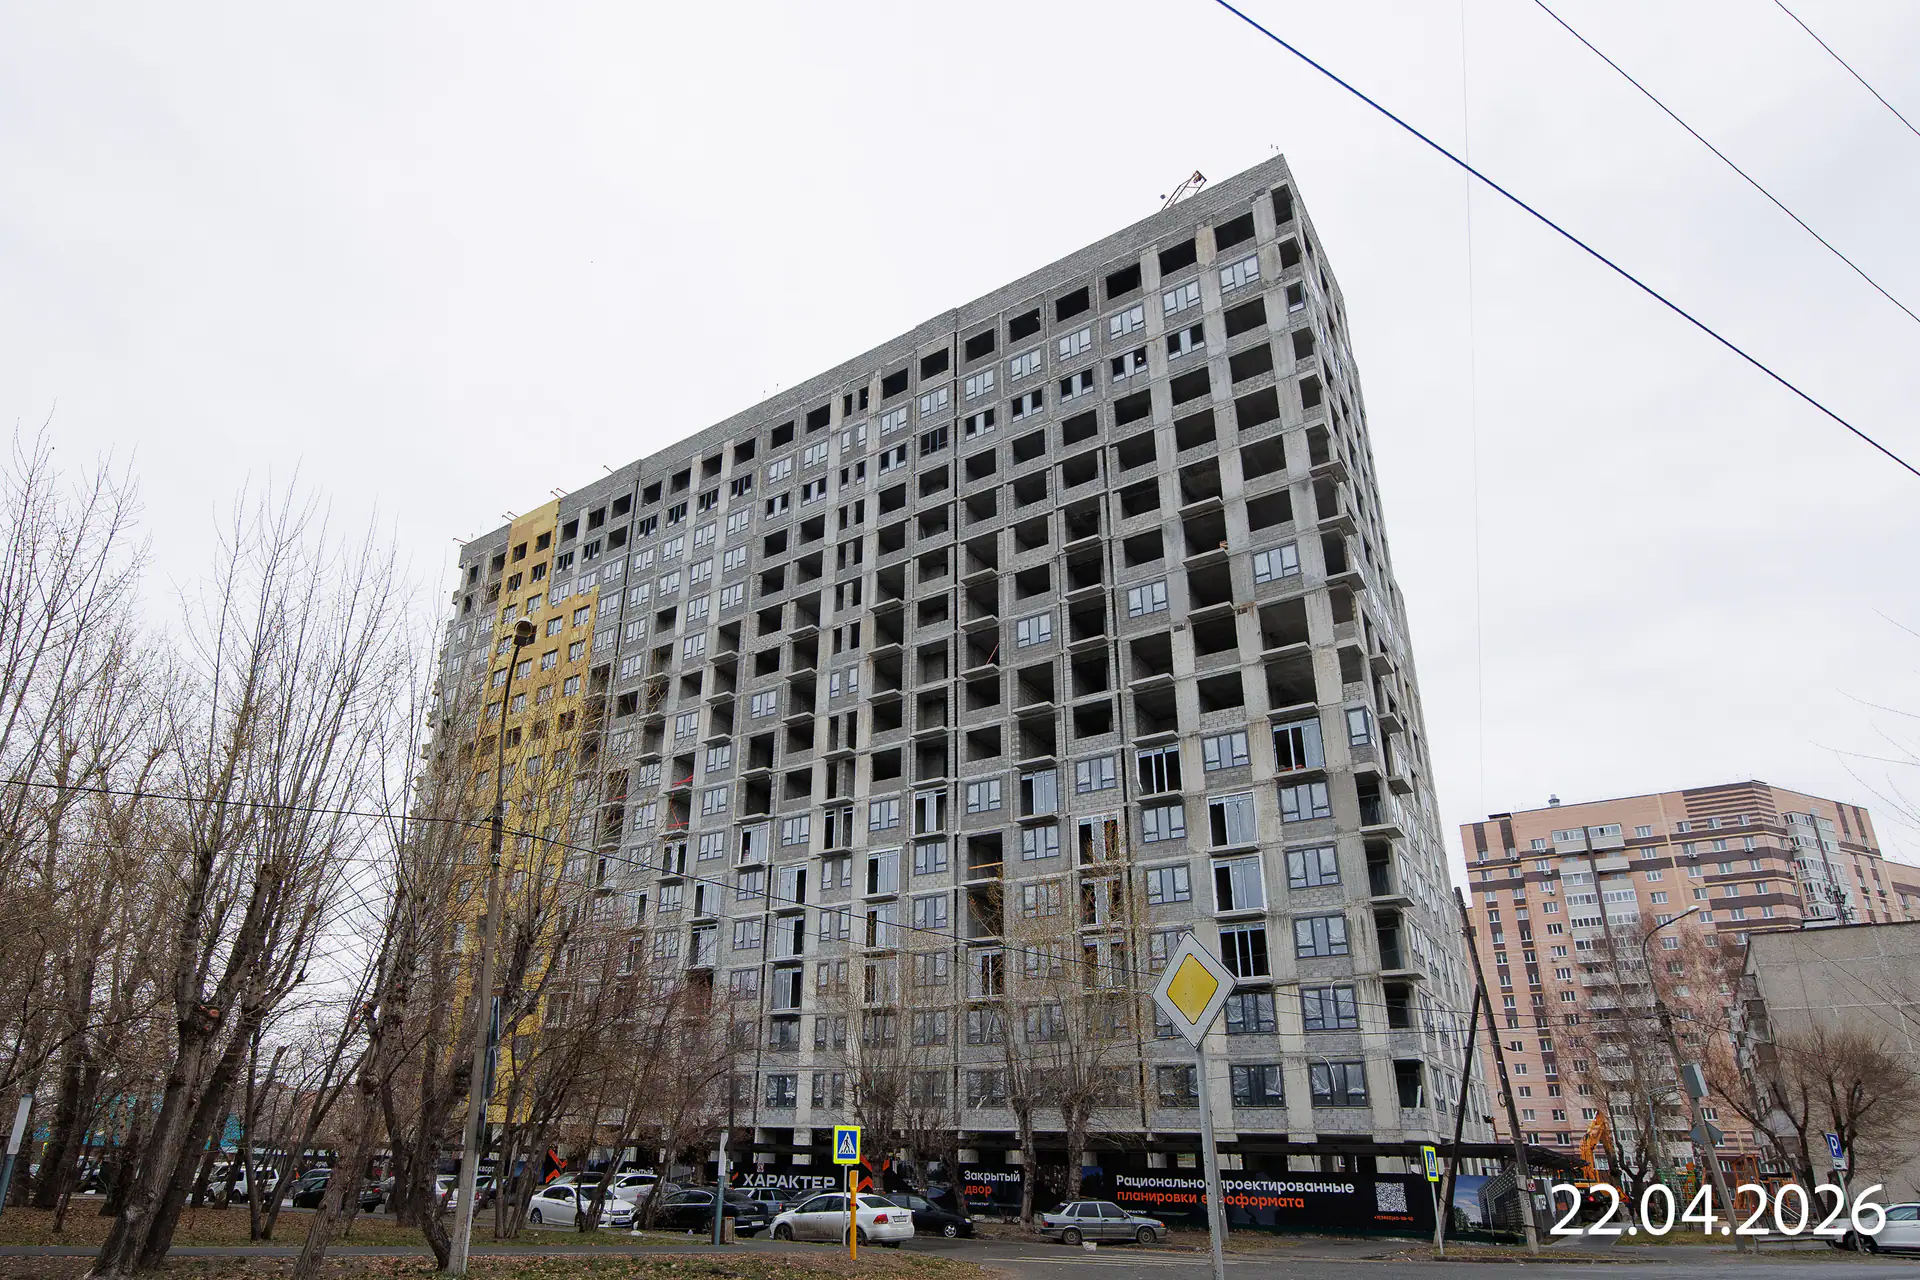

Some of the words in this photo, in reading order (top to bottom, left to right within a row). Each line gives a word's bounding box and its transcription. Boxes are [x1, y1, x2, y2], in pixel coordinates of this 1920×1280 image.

[1830, 1136, 1838, 1156] P
[743, 1173, 836, 1189] ХАРАКТЕР
[964, 1170, 1021, 1184] Закрытый
[1116, 1174, 1206, 1189] Рационально
[1220, 1180, 1355, 1195] проектированные
[964, 1184, 992, 1198] двор
[1117, 1191, 1197, 1205] планировки
[1201, 1192, 1305, 1210] еоформата
